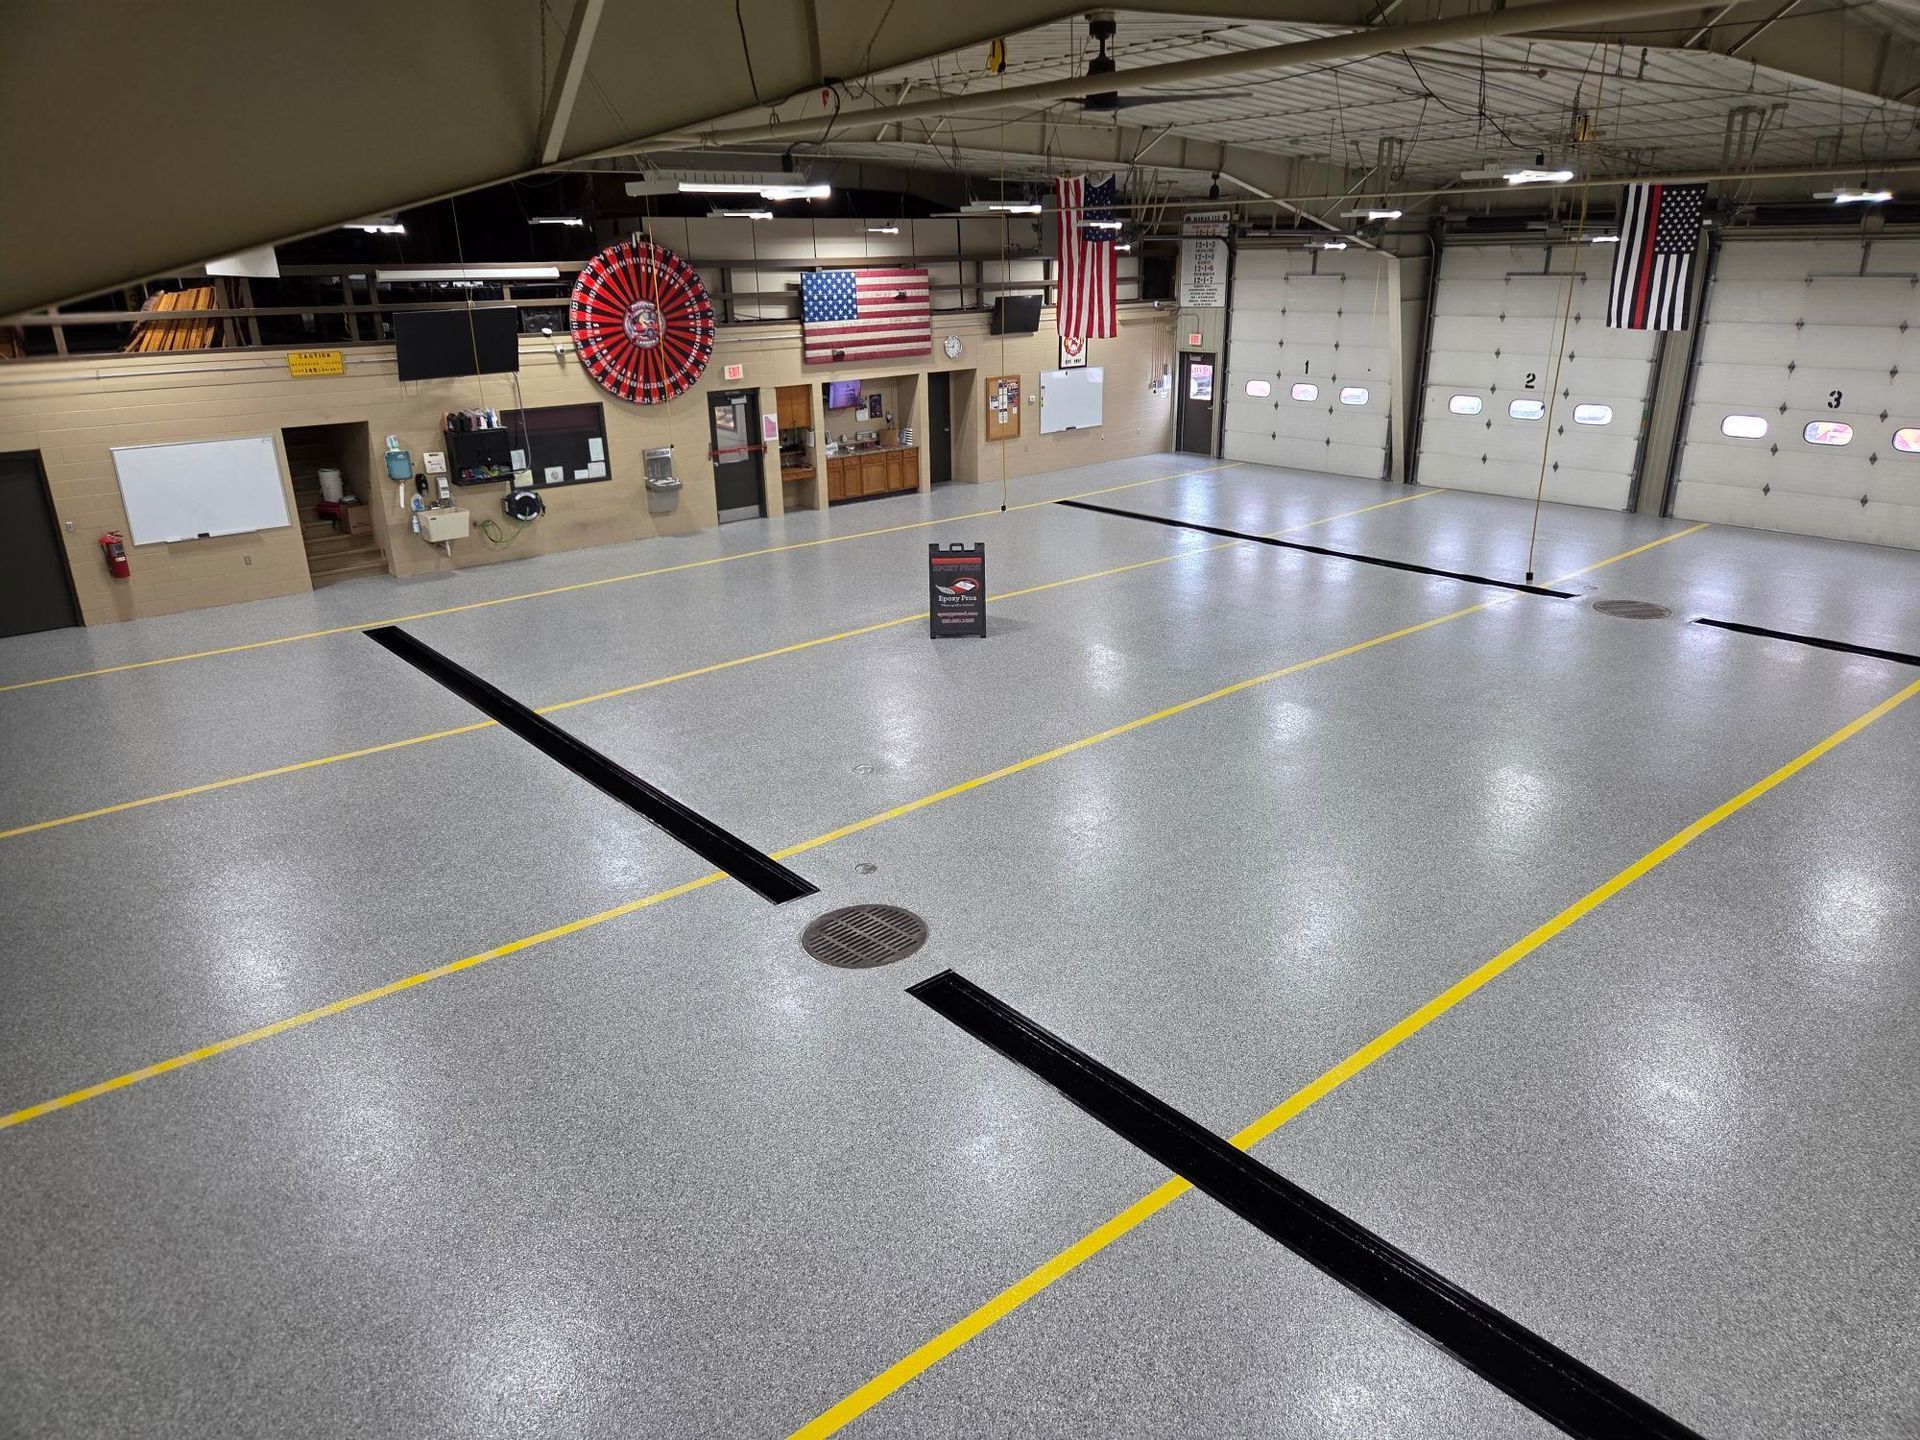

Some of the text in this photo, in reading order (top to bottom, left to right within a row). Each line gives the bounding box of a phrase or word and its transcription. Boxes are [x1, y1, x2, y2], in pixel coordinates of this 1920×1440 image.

[1305, 360, 1310, 374] 1
[1524, 372, 1536, 389] 2
[1828, 390, 1842, 408] 3
